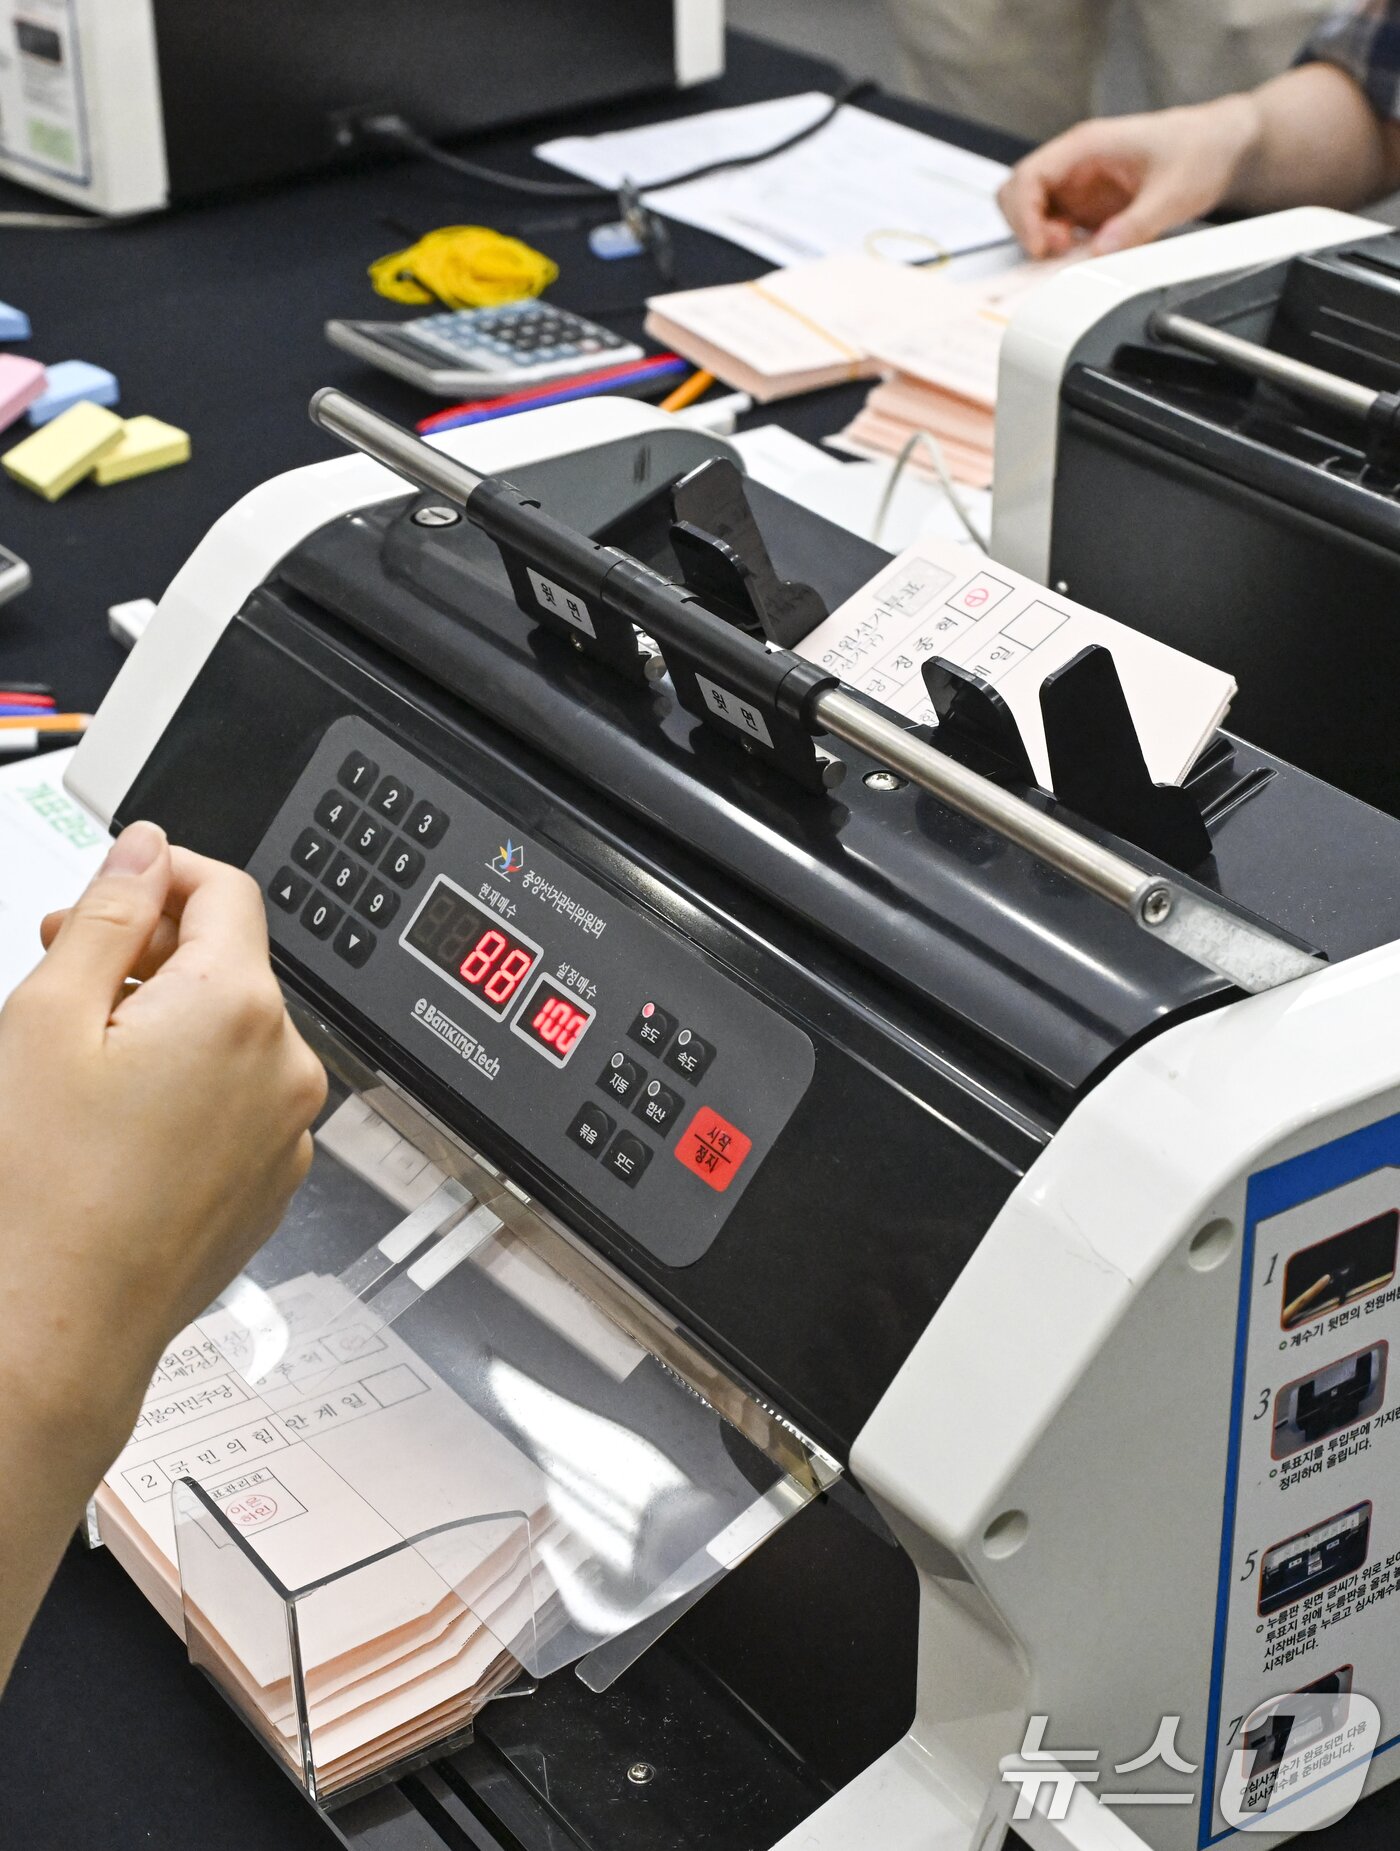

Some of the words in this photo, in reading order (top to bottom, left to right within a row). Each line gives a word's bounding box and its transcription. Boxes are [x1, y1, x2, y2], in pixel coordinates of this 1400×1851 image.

[353, 767, 365, 783] 1
[383, 790, 398, 808] 2
[329, 805, 343, 822] 4
[419, 815, 432, 833] 3
[305, 842, 320, 860] 7
[361, 828, 375, 846] 5
[337, 868, 351, 886] 8
[395, 854, 409, 872] 6
[370, 894, 384, 912] 9
[477, 882, 517, 919] 현재매수
[522, 870, 607, 939] 중앙선거관리위원회
[313, 906, 327, 925] 0
[460, 930, 531, 1002] 88
[557, 962, 597, 998] 설정매수
[532, 997, 588, 1054] 100
[640, 1023, 660, 1043] 농도
[677, 1052, 698, 1071] 속도
[609, 1072, 629, 1094] 자동
[645, 1101, 666, 1123] 합산
[579, 1123, 598, 1145] 묶음
[707, 1127, 732, 1152] 시작
[614, 1152, 635, 1174] 모드
[695, 1145, 720, 1173] 정지
[1264, 1253, 1278, 1286] 1
[1290, 1323, 1324, 1347] 계수기
[1328, 1306, 1360, 1331] 뒷면의
[1253, 1388, 1271, 1420] 3
[1280, 1445, 1324, 1474] 투표지를
[1328, 1421, 1370, 1451] 투입부에
[1280, 1460, 1322, 1490] 정리하여
[1327, 1438, 1371, 1468] 올립니다.
[141, 1474, 158, 1488] 2
[1241, 1550, 1258, 1581] 5
[1265, 1619, 1298, 1643] 투표지
[1302, 1607, 1322, 1625] 위에
[1325, 1584, 1367, 1613] 누름판을
[1370, 1570, 1390, 1590] 올려
[1267, 1605, 1299, 1628] 누름판
[1302, 1592, 1323, 1611] 윗면
[1327, 1574, 1359, 1600] 글씨가
[1361, 1562, 1381, 1580] 위로
[1264, 1623, 1317, 1658] 시작버튼을
[1320, 1606, 1351, 1629] 누르고
[1262, 1638, 1319, 1673] 시작합니다.
[1226, 1714, 1243, 1745] 7
[1248, 1757, 1300, 1794] 심사계수가
[1303, 1732, 1343, 1760] 완료되면
[1347, 1720, 1367, 1738] 다음
[1302, 1743, 1355, 1778] 준비합니다.
